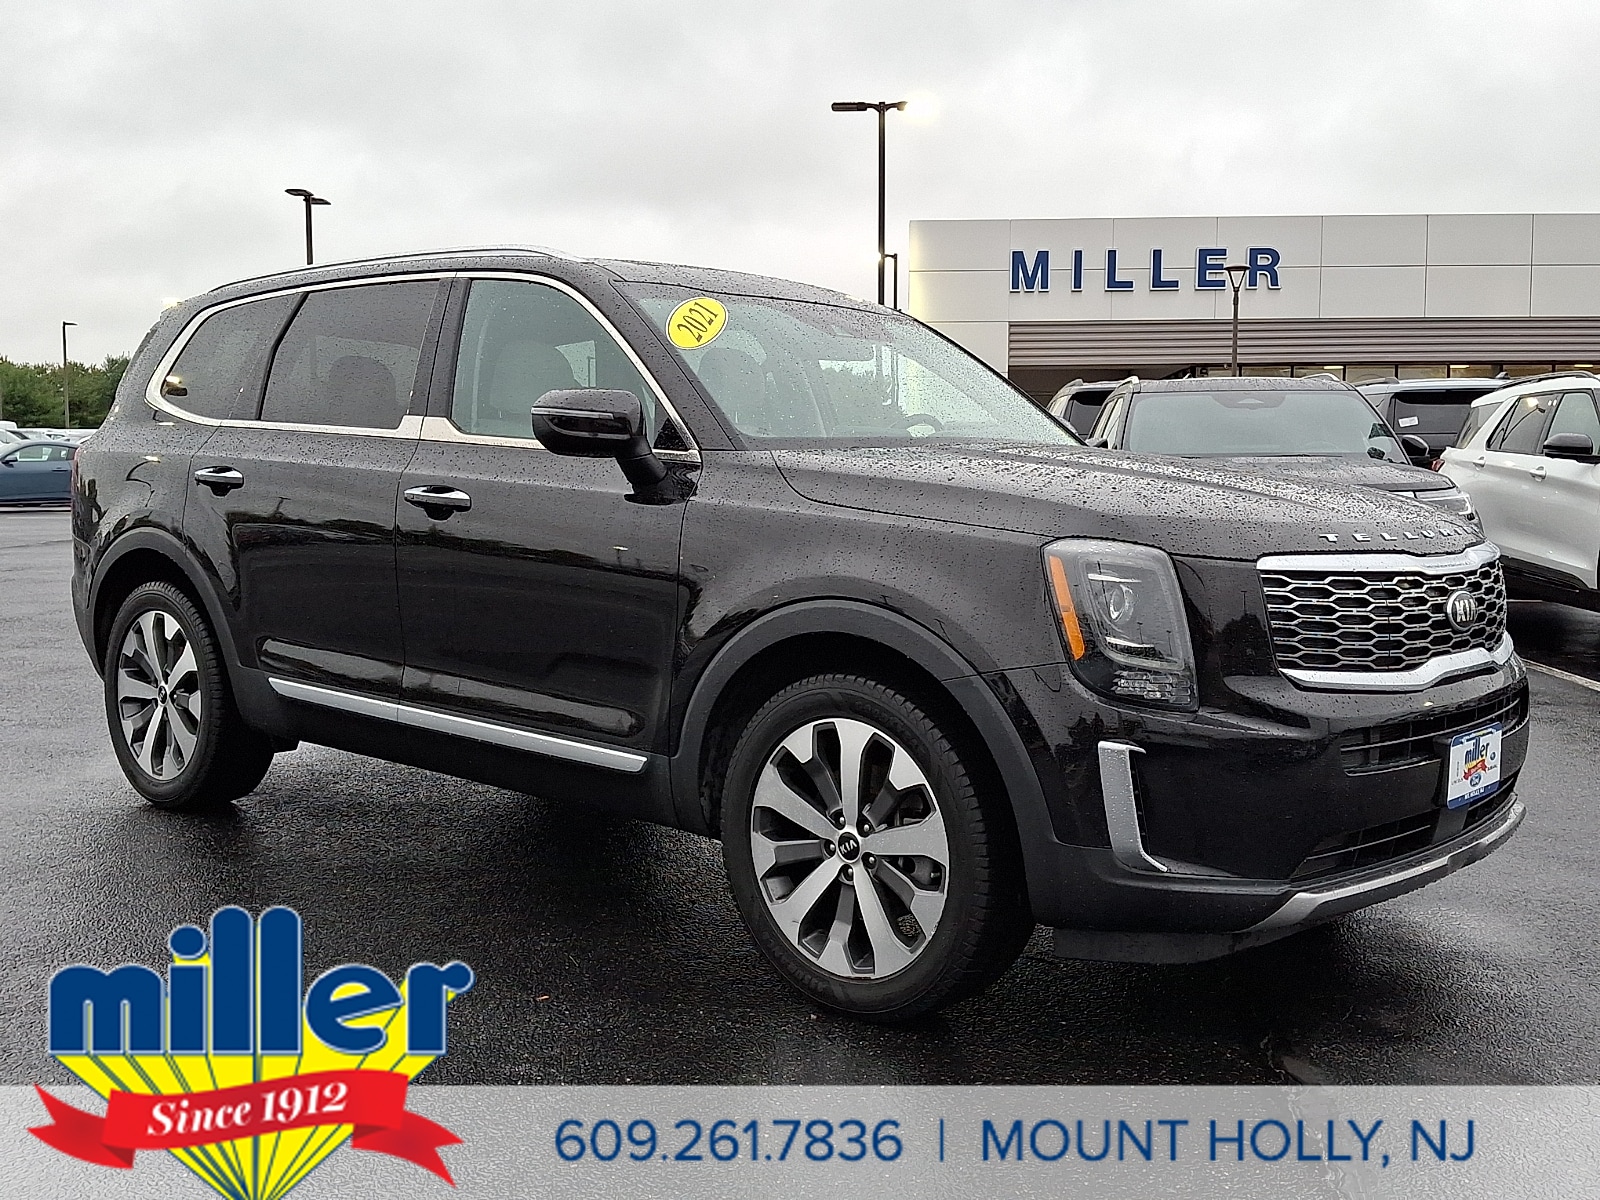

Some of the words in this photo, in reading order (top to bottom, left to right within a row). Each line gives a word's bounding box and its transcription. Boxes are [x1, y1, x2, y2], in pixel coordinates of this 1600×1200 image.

[1009, 247, 1282, 292] MILLER
[677, 302, 719, 342] 2021
[1465, 736, 1490, 767] miller
[840, 839, 857, 855] KIA
